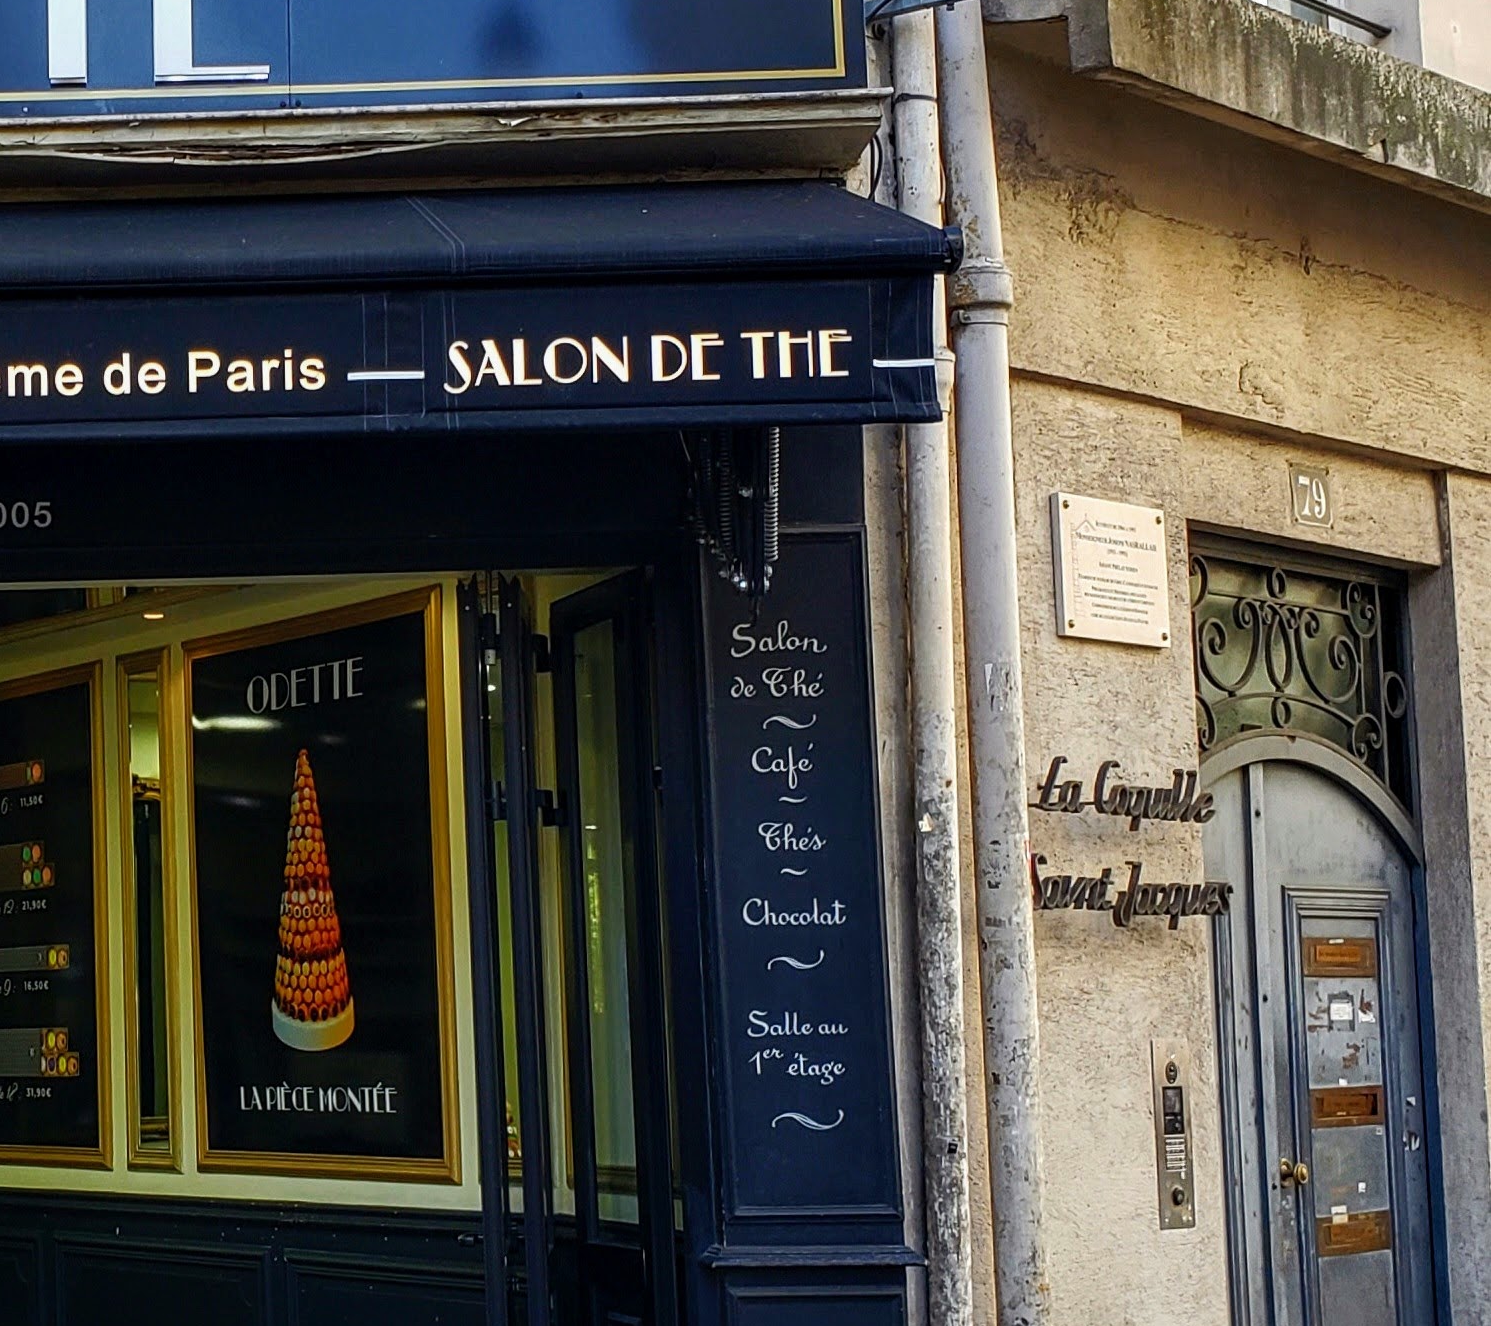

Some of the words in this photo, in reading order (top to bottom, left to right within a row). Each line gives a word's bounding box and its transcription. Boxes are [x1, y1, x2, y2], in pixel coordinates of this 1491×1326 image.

[103, 352, 167, 396] de
[187, 348, 326, 393] Paris
[443, 335, 629, 395] SALON
[651, 332, 725, 382] DE
[740, 328, 853, 379] THE
[1298, 475, 1327, 519] 79
[731, 621, 827, 658] Salon
[245, 657, 364, 714] ODETTE
[731, 676, 757, 698] de
[762, 667, 824, 698] Thé
[751, 743, 815, 789] Café
[1032, 756, 1085, 813] La
[1094, 760, 1216, 831] Coquille
[758, 823, 827, 852] Thés
[742, 898, 847, 927] Chocolat
[1113, 861, 1233, 930] Jacques
[747, 1011, 814, 1035] Salle
[818, 1021, 849, 1035] au
[788, 1051, 846, 1084] étage
[240, 1085, 262, 1111] LA
[266, 1080, 314, 1112] PIÈCE
[319, 1083, 398, 1113] MONTÉE
